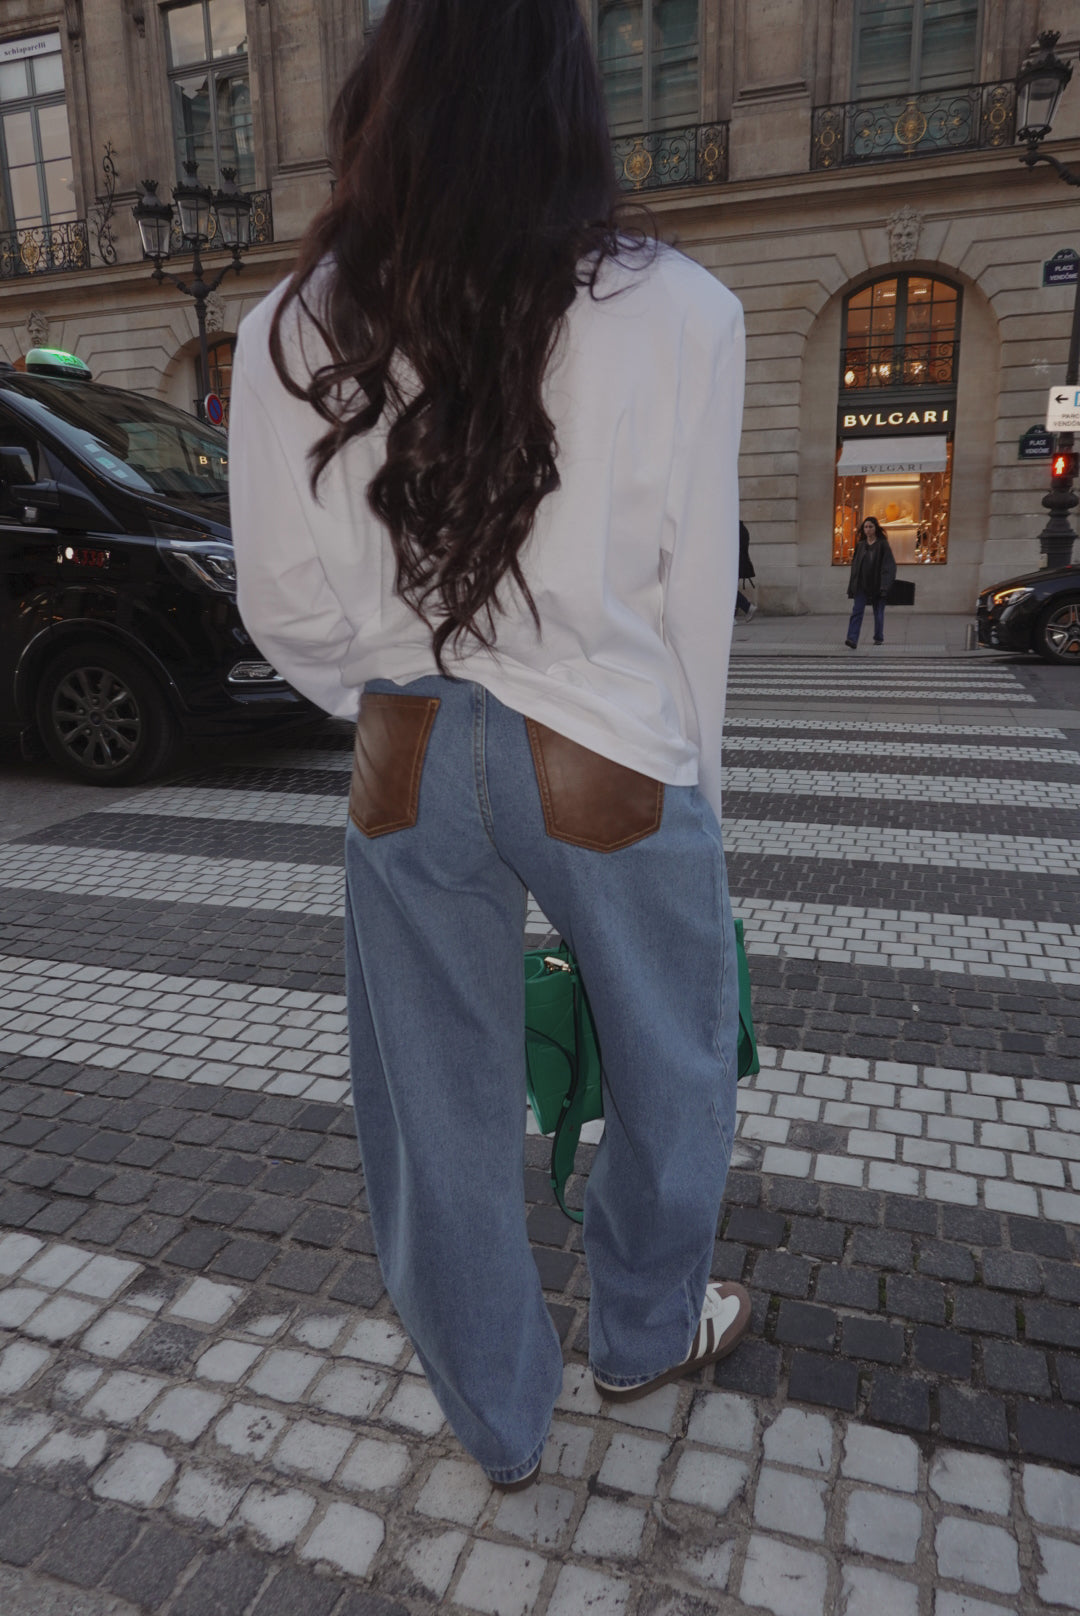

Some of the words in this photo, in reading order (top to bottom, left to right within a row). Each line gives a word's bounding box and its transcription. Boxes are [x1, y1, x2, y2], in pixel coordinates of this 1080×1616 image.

[4, 41, 46, 55] schiaparelli
[843, 409, 949, 427] BVLGARI
[861, 463, 923, 473] BVLGARI
